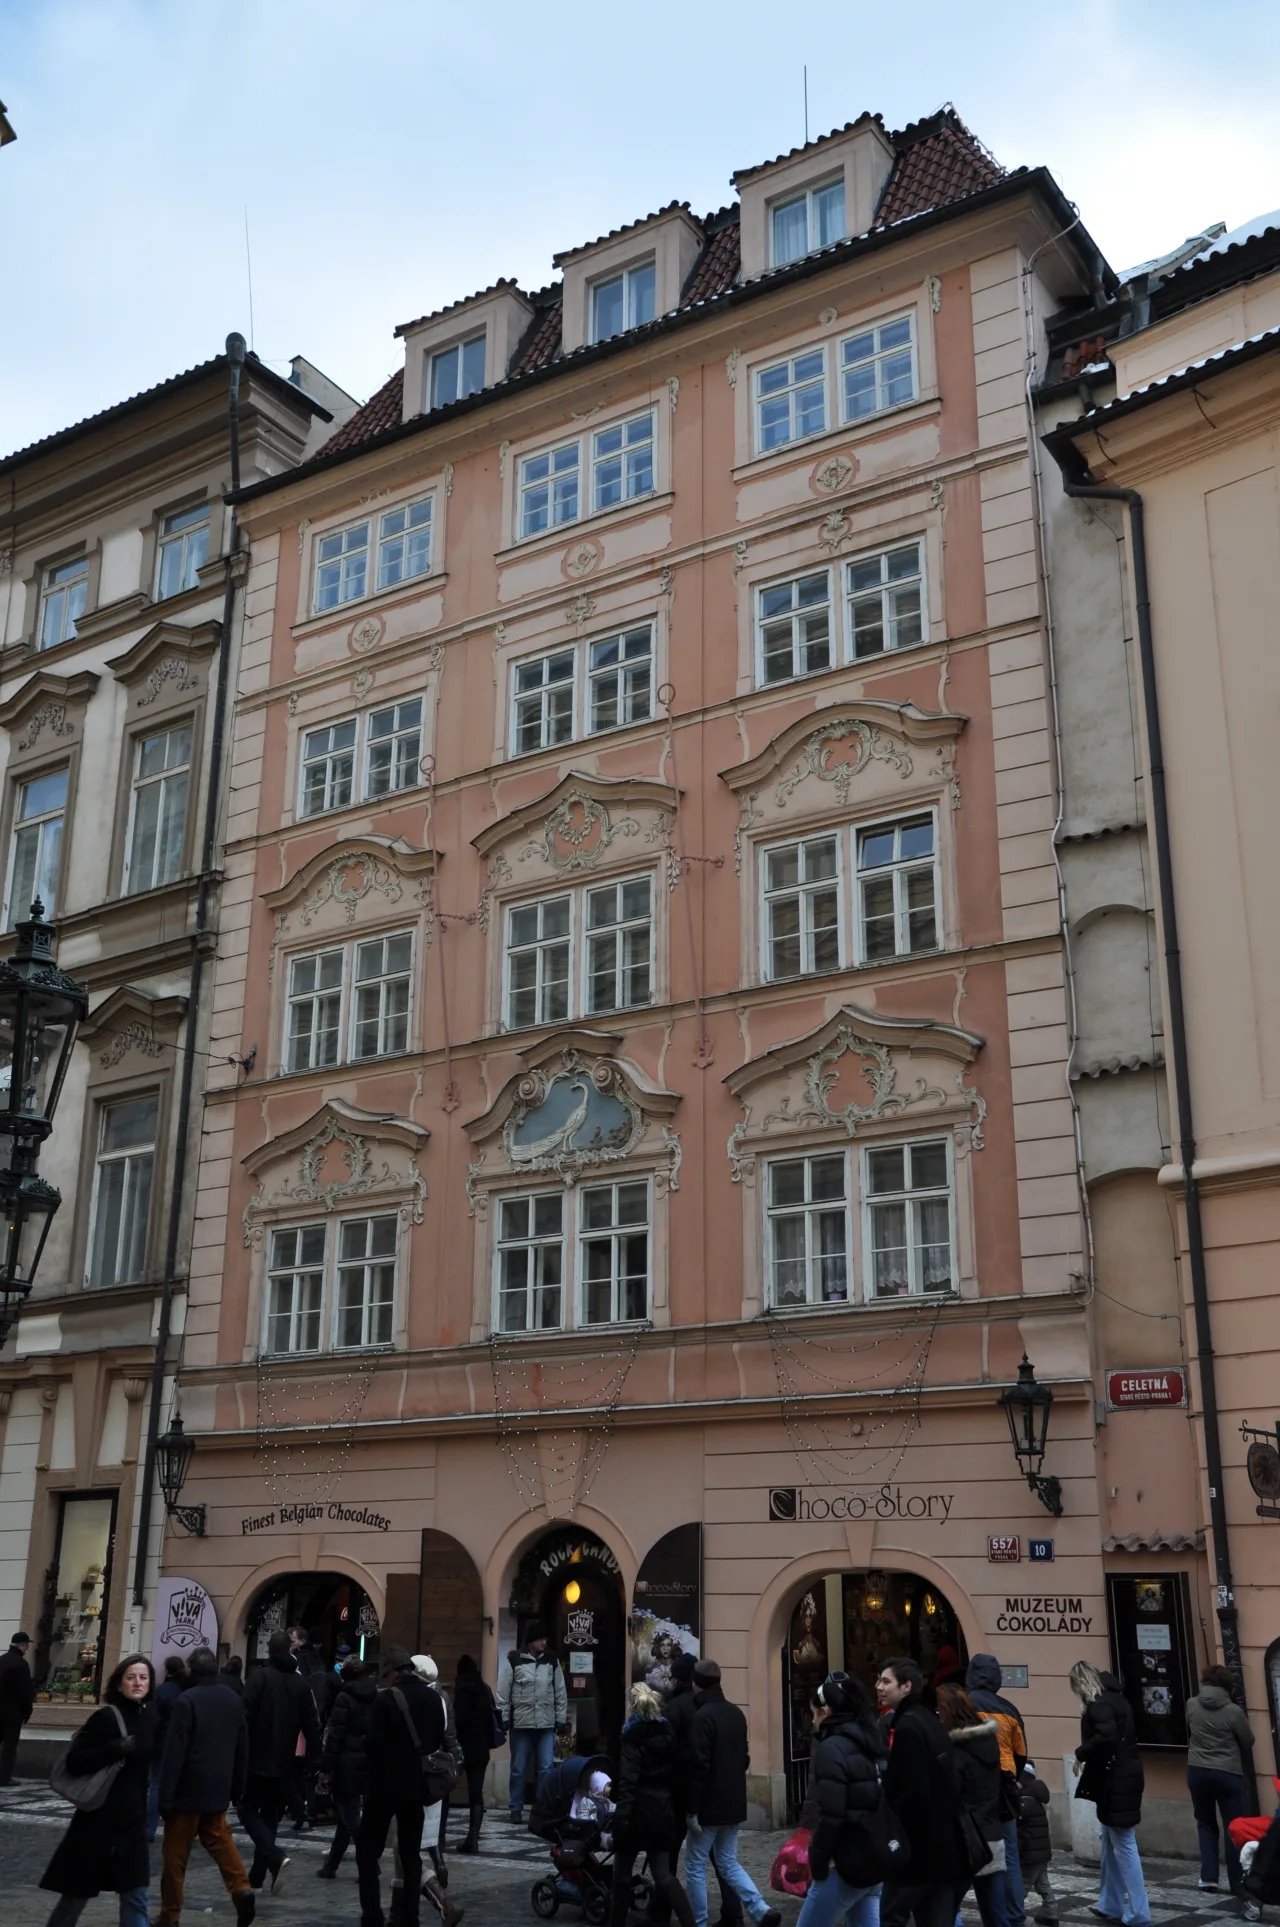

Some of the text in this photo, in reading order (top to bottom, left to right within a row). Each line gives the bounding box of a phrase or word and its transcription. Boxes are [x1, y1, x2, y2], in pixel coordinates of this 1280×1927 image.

[1121, 1376, 1169, 1391] CELETNÁ
[1120, 1392, 1134, 1400] STARÉ
[769, 1484, 955, 1525] Choco-Story
[241, 1504, 391, 1535] Finest Belgian Chocolates
[992, 1538, 1013, 1549] 557
[1035, 1544, 1046, 1556] 10
[540, 1541, 621, 1577] ROCK CANDY
[1005, 1598, 1083, 1613] MUZEUM
[996, 1613, 1093, 1632] ČOKOLÁDY
